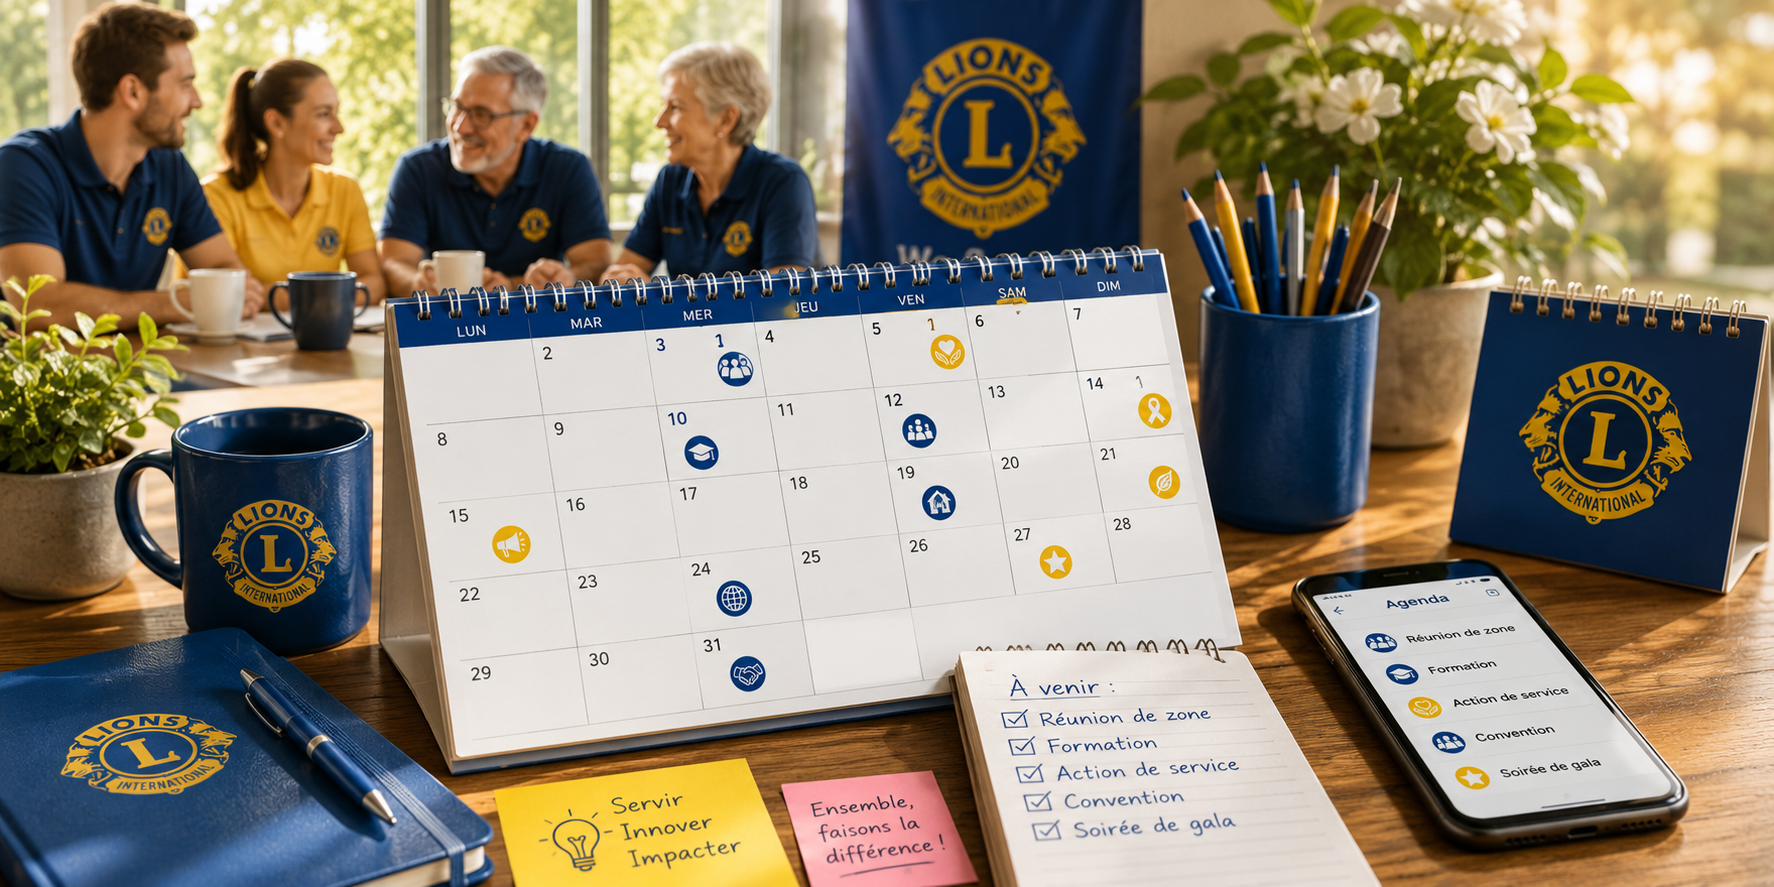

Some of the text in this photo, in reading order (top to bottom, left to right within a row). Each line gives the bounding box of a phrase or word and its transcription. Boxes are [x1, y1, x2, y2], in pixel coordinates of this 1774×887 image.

[933, 45, 1044, 87] LIONS
[962, 99, 1013, 168] L
[456, 280, 1121, 338] LUN MAR MER JEU VEN SAM DIM
[542, 307, 1082, 361] 2 3 1 4 5 1 6 7
[1566, 365, 1663, 406] LIONS
[437, 431, 448, 447] 8
[553, 421, 564, 436] 9
[667, 411, 688, 426] 10
[777, 402, 794, 417] 11
[884, 393, 903, 407] 12
[988, 385, 1006, 399] 13
[1086, 376, 1104, 390] 14
[1582, 410, 1627, 470] L
[448, 447, 1116, 523] 15 16 17 18 19 20 21
[1550, 476, 1646, 513] INTERNATIONAL
[237, 502, 310, 527] LIONS
[259, 534, 293, 573] L
[459, 517, 1132, 603] 22 23 24 25 26 27 28
[239, 582, 311, 604] INTERNATIONAL
[1386, 593, 1451, 610] Agenda
[1405, 624, 1516, 645] Réunion de zone
[470, 637, 721, 682] 29 30 31
[1427, 658, 1498, 675] Formation
[1009, 674, 1028, 697] À
[1039, 679, 1099, 696] venir
[1452, 685, 1570, 708] Action de service
[82, 715, 181, 743] LIONS
[1039, 708, 1211, 727] Réunion de zone
[1047, 736, 1158, 754] Formation
[1475, 724, 1556, 743] Convention
[120, 737, 182, 769] L
[116, 764, 215, 791] INTERNATIONAL
[1057, 758, 1240, 781] Action de service
[1500, 756, 1602, 779] Soirée de gala
[611, 793, 684, 814] Servir
[810, 794, 915, 818] Ensemble,
[1064, 790, 1185, 810] Convention
[620, 817, 713, 841] Innover
[818, 816, 920, 843] faisons la
[1073, 812, 1236, 839] Soirée de gala
[627, 841, 742, 869] Impacter
[826, 833, 946, 864] différence !
